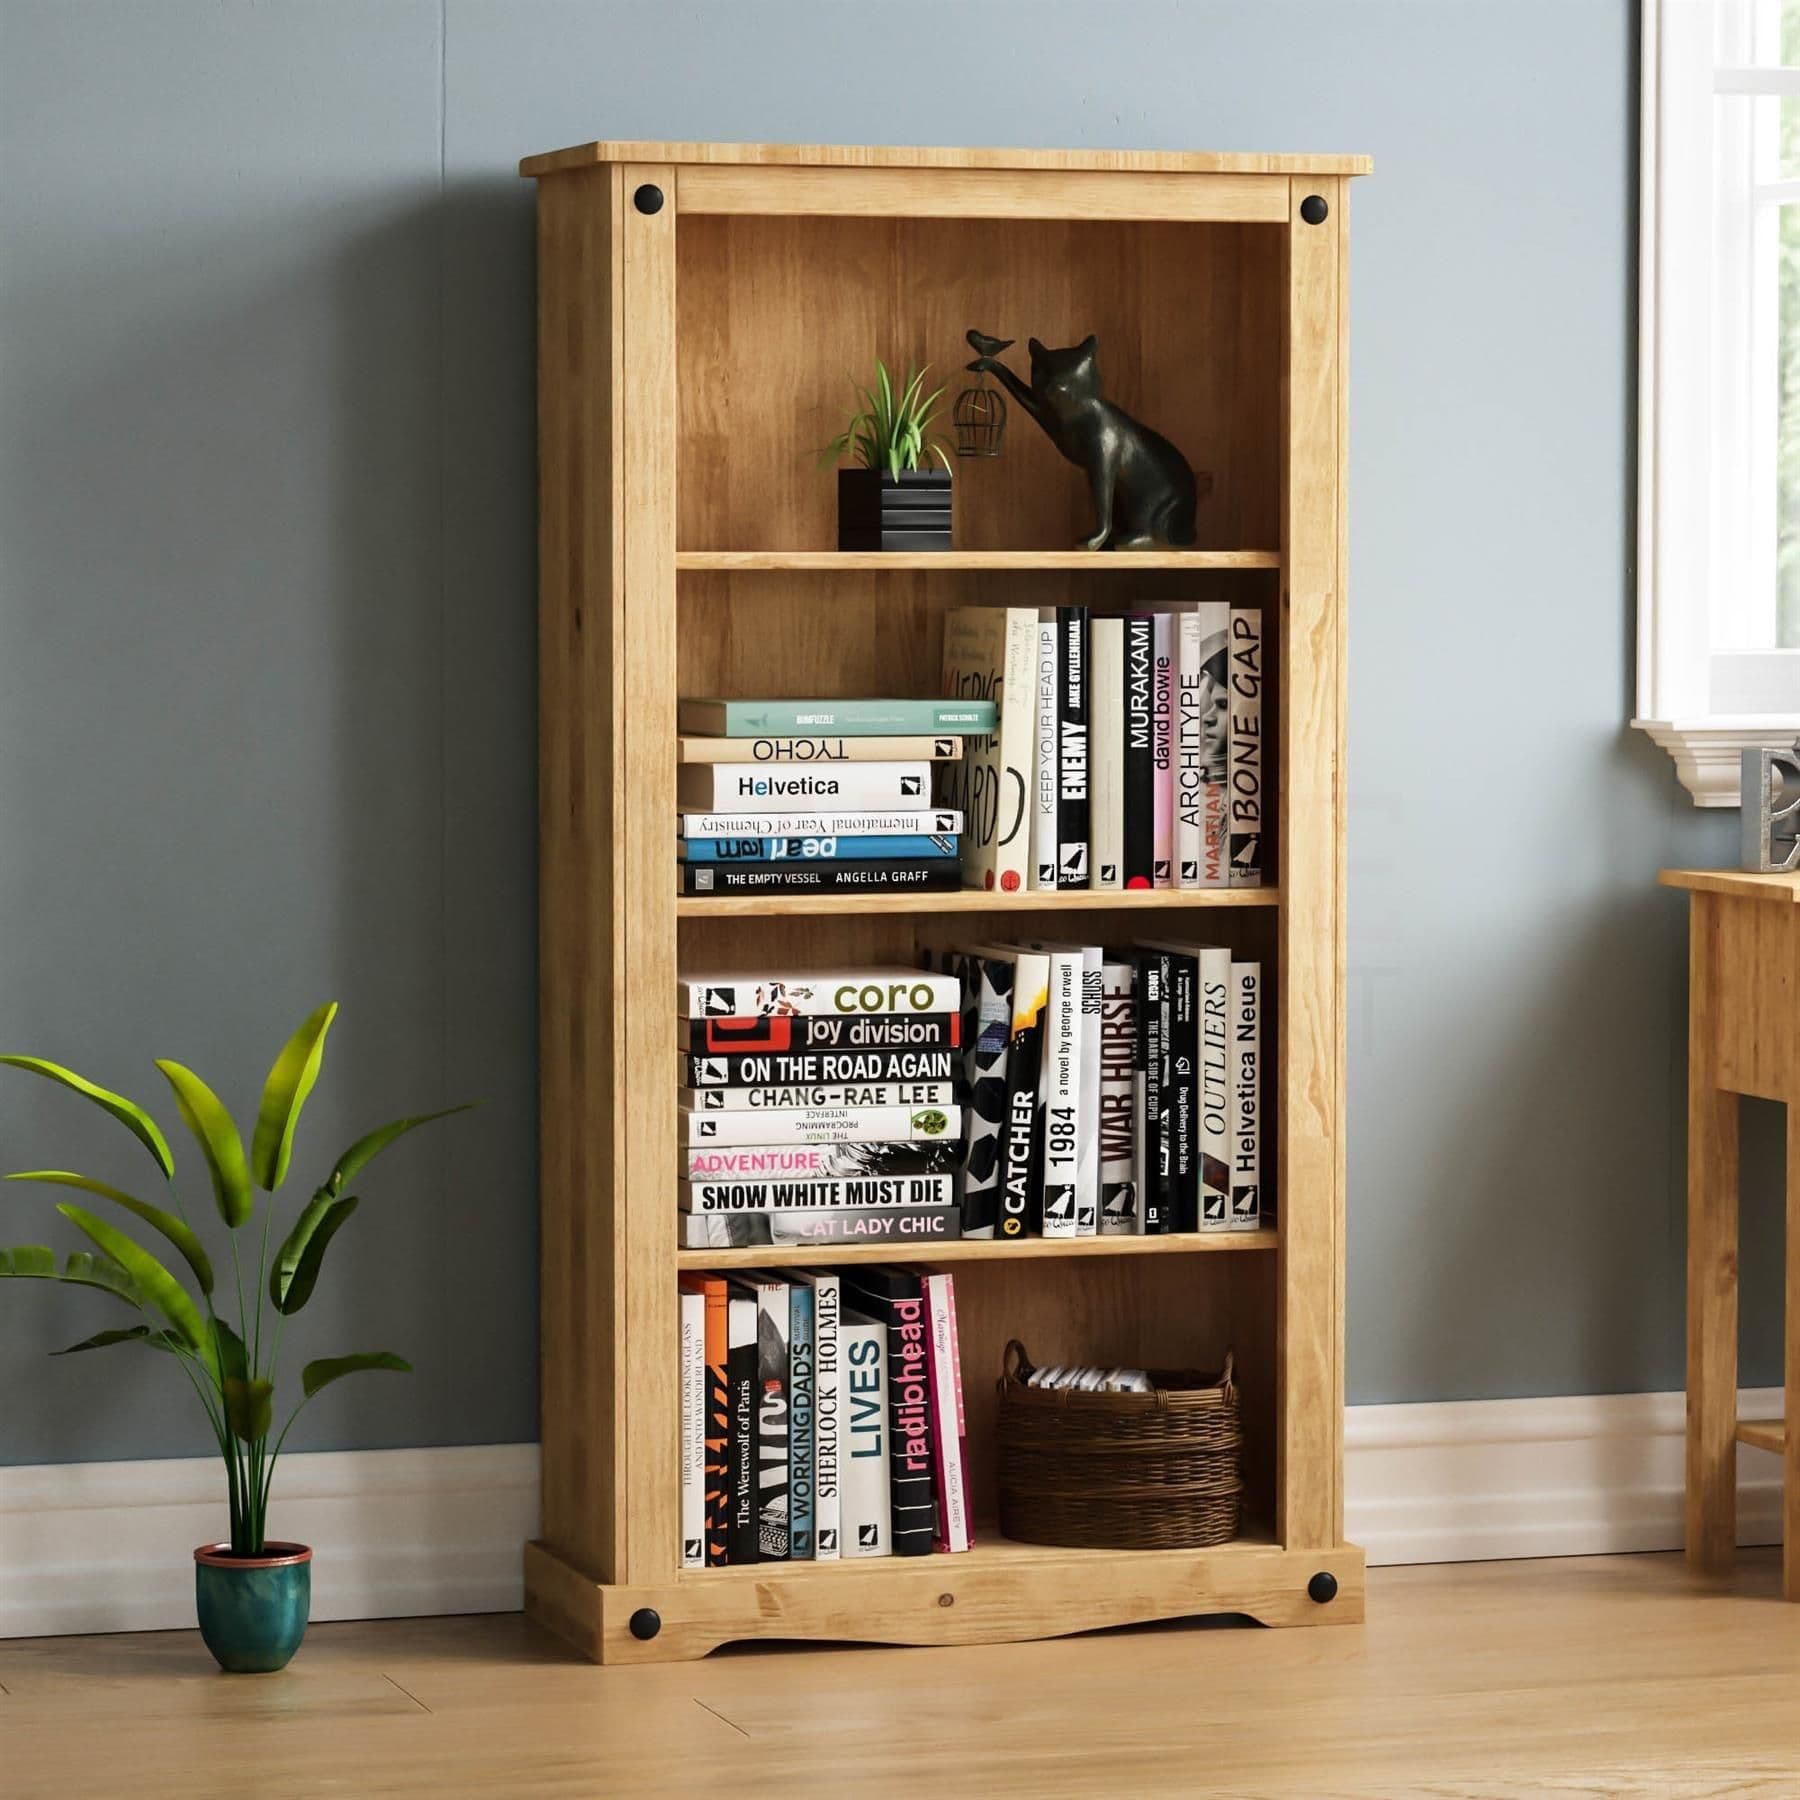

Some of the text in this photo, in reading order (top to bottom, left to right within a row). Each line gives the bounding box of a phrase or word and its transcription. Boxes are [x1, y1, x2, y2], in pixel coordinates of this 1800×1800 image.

[1040, 631, 1054, 815] KEEP YOUR HEAD UP
[1069, 684, 1081, 708] JAKE
[1131, 621, 1149, 749] MURAKAMI
[1154, 656, 1170, 771] david bowie
[1232, 616, 1260, 823] BONE GAP
[738, 777, 839, 796] Helvetica
[753, 739, 849, 761] TYCHO
[1061, 721, 1087, 800] ENEMY
[1180, 674, 1200, 827] ARCHITYPE
[699, 816, 919, 834] International Year of Chemistry
[769, 837, 838, 861] pearl
[1205, 782, 1221, 880] MARTIAN
[726, 873, 821, 885] THE EMPTY VESSEL
[835, 871, 929, 883] ANGELLA GRAFF
[806, 1016, 939, 1046] joy division
[834, 983, 935, 1013] coro
[1059, 965, 1072, 1096] a novel by george orwell
[1082, 970, 1102, 1015] SCHUSS
[740, 1053, 951, 1082] ON THE ROAD AGAIN
[748, 1085, 939, 1106] CHANG-RAE LEE
[1101, 985, 1133, 1163] WAR HORSE
[1148, 1020, 1158, 1121] THE DARK SIDE OF CUPID
[1203, 982, 1227, 1136] OUTLIERS
[1236, 975, 1257, 1172] Helvetica Neue
[795, 1120, 859, 1130] PROGRAMMING
[806, 1110, 848, 1119] INTERFACE
[806, 1132, 848, 1141] THE LINUX
[1004, 1091, 1035, 1215] CATCHER
[1050, 1106, 1075, 1167] 1984
[1177, 1087, 1189, 1174] Drug Delivery to the Brain
[690, 1152, 820, 1173] ADVENTURE
[702, 1178, 943, 1210] SNOW WHITE MUST DIE
[842, 1217, 894, 1235] LADY
[899, 1216, 945, 1233] CHIC
[683, 1322, 692, 1487] THROUGH THE LOOKING GLASS
[695, 1338, 704, 1470] AND INTO WONDERLAND
[818, 1286, 837, 1498] SHERLOCK HOLMES
[848, 1339, 882, 1459] LIVES
[894, 1299, 928, 1471] radiohead
[738, 1379, 750, 1528] The Werewolf of Paris
[793, 1343, 812, 1521] WORKING DAD'S
[947, 1462, 961, 1529] ALICIA AIREY
